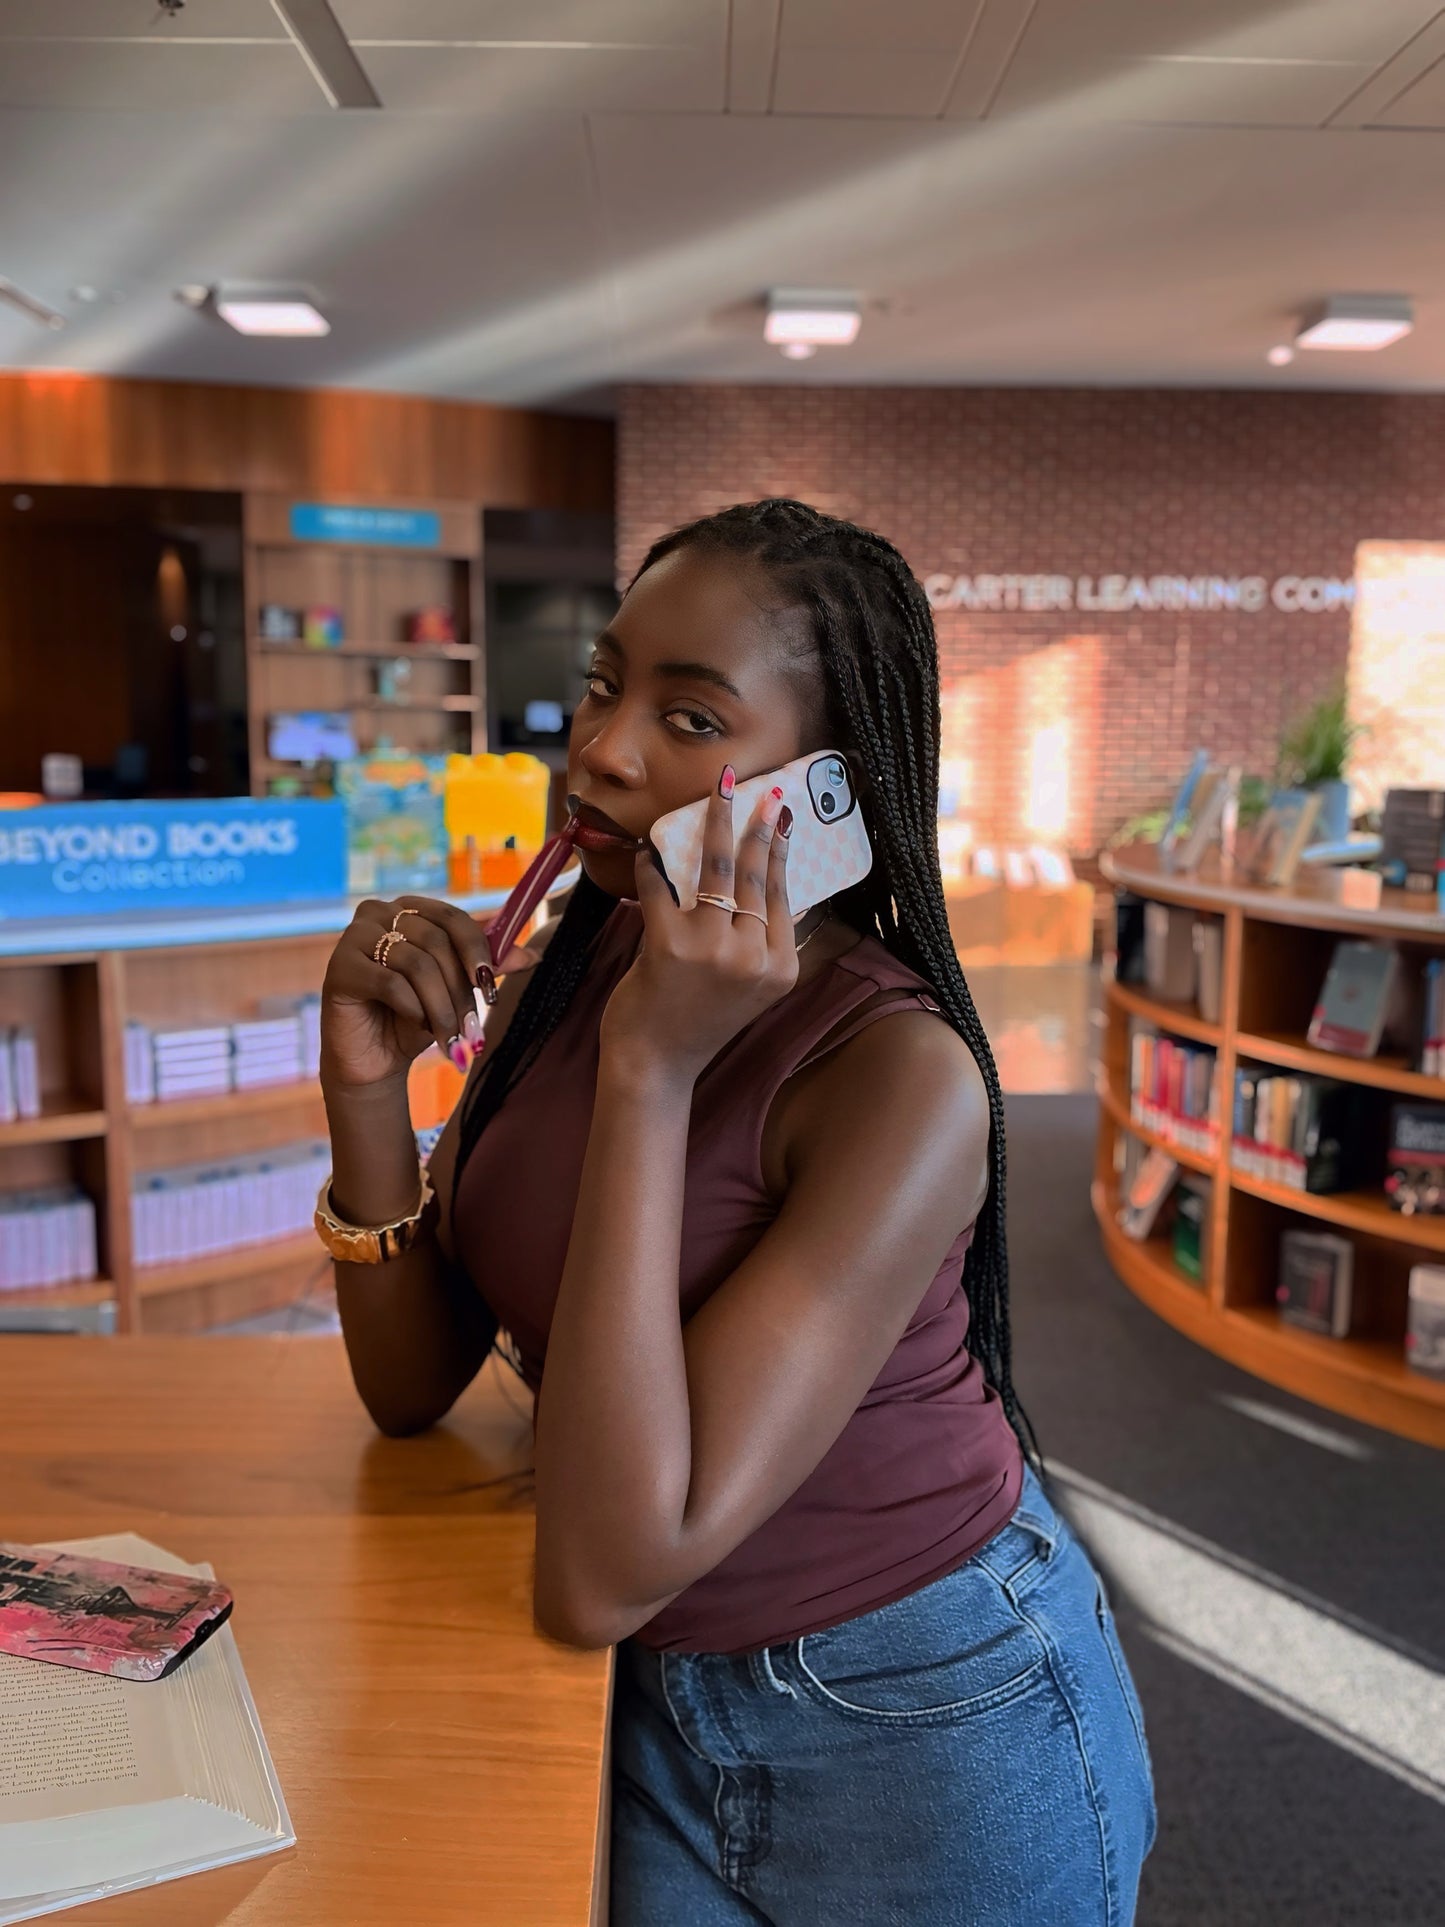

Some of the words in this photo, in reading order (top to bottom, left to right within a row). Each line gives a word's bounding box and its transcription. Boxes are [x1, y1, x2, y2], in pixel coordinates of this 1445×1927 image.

[924, 574, 1073, 612] CARTER
[1076, 575, 1267, 613] LEARNING
[166, 819, 298, 859] BOOKS
[52, 859, 246, 893] Collection
[47, 1691, 82, 1700] followed
[83, 1685, 112, 1695] nightly
[61, 1704, 99, 1712] Belafonte
[100, 1698, 125, 1706] would
[100, 1712, 128, 1721] looked
[13, 1754, 51, 1762] libations
[52, 1748, 94, 1757] including
[95, 1742, 133, 1752] premium
[15, 1762, 41, 1770] bottle
[55, 1756, 90, 1766] Johnnie
[54, 1764, 80, 1772] drank
[12, 1779, 38, 1787] Lewis
[39, 1773, 74, 1782] thought
[102, 1766, 124, 1774] quite
[114, 1772, 139, 1780] going
